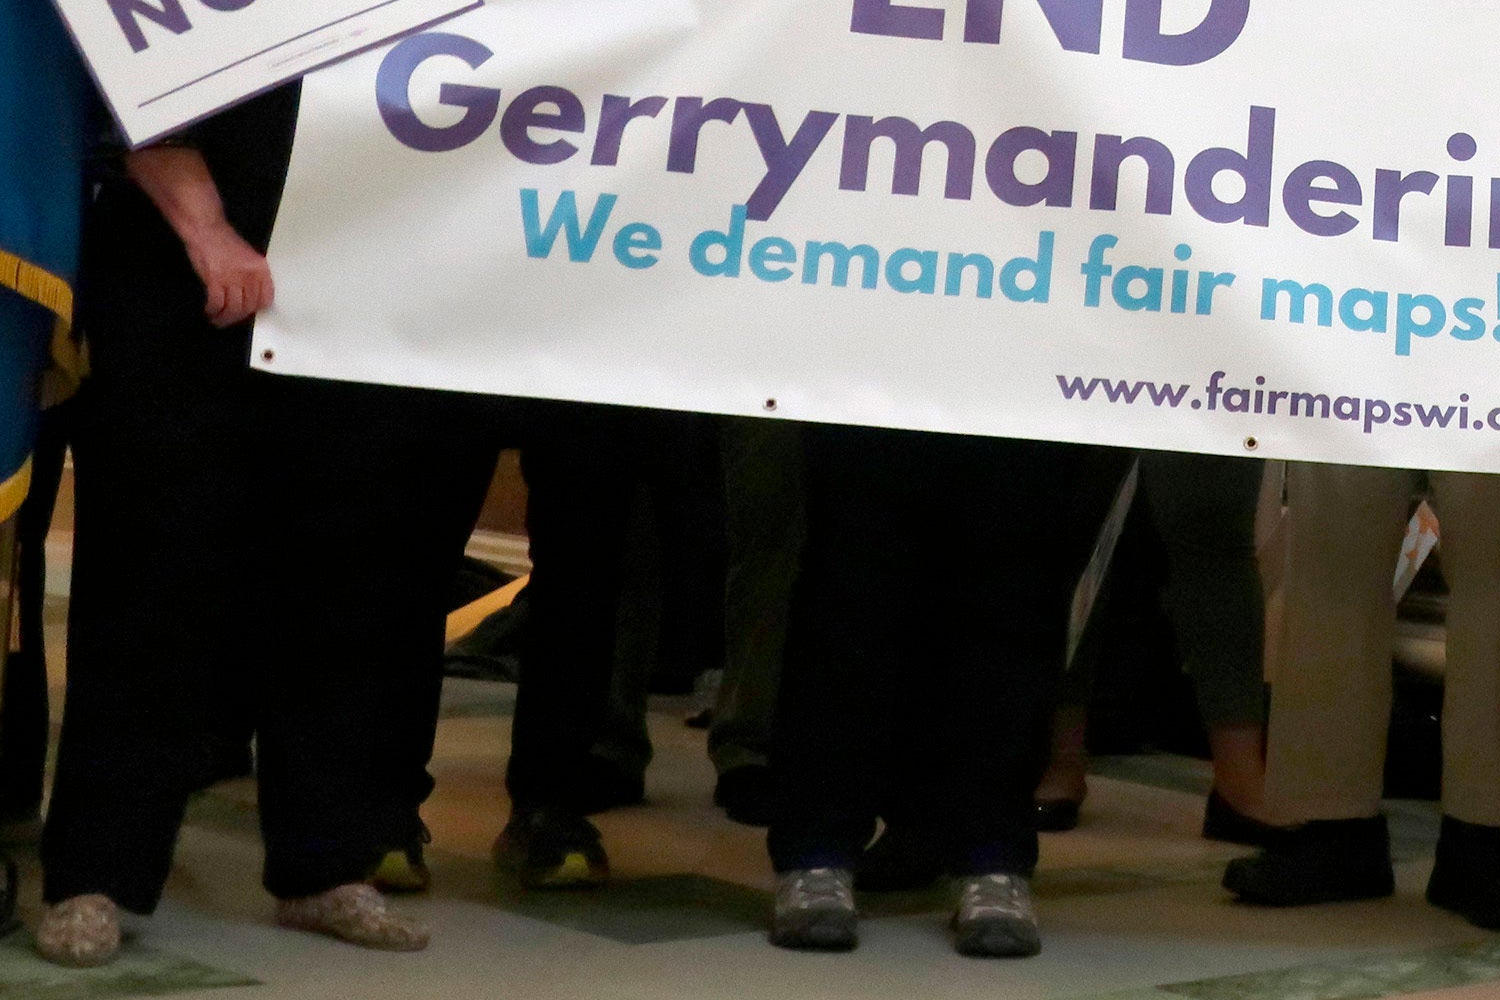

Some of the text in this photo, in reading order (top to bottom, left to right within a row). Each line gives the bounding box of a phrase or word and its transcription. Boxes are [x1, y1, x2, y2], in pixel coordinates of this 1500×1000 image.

[519, 188, 663, 270] We
[689, 204, 1055, 304] demand
[1081, 235, 1236, 315] fair
